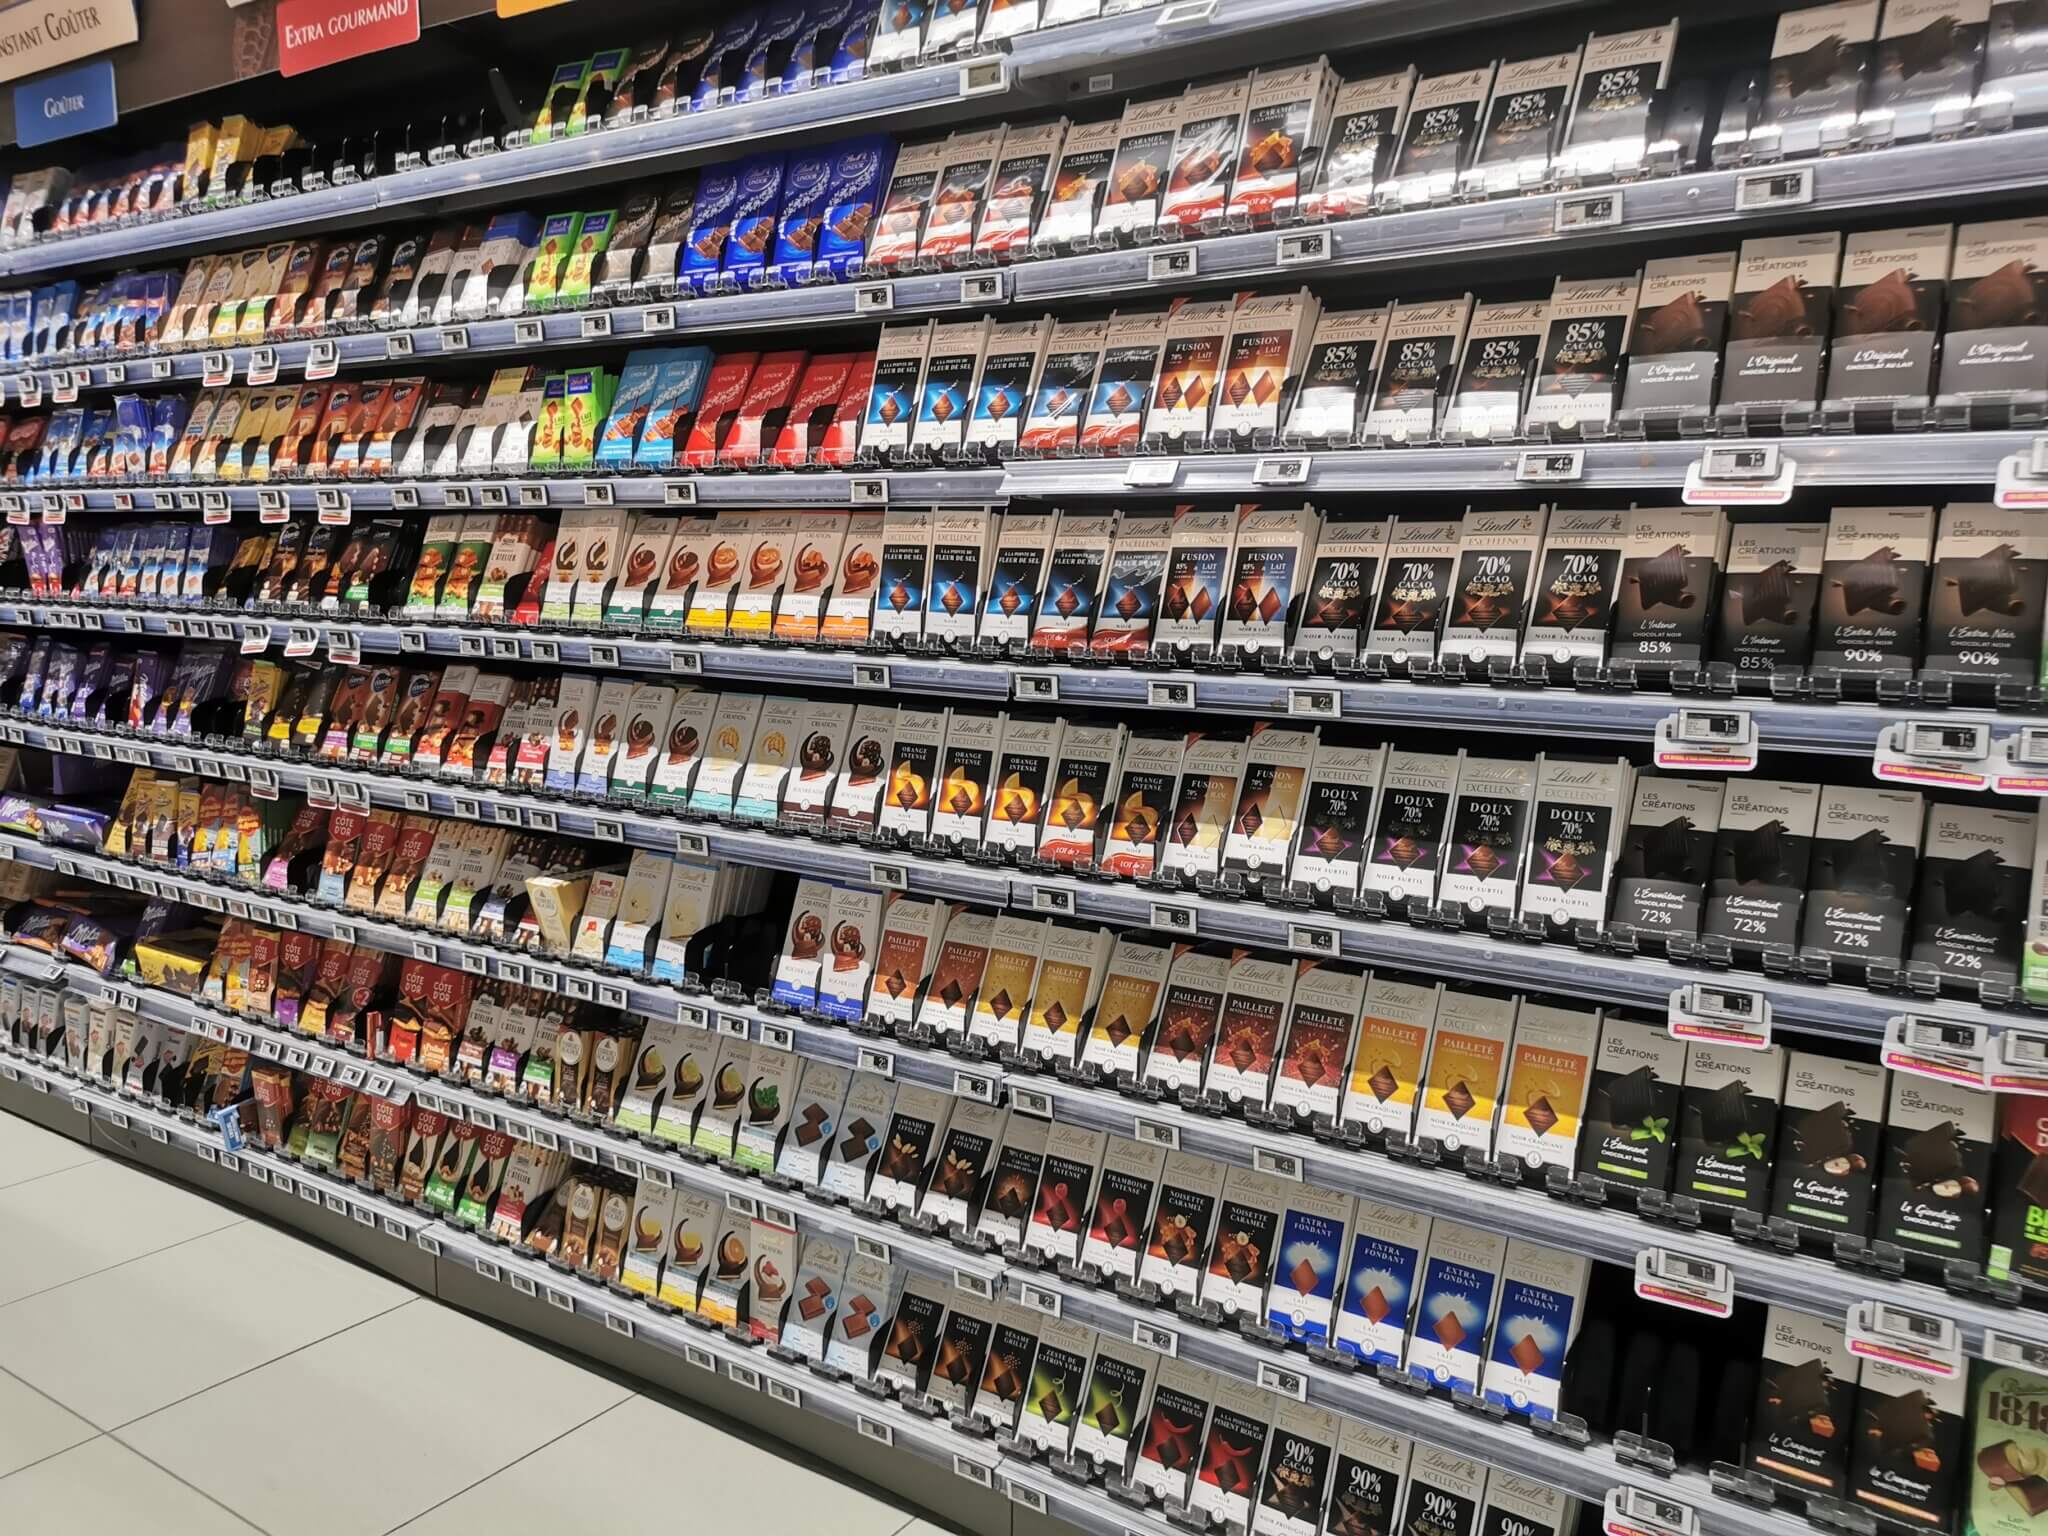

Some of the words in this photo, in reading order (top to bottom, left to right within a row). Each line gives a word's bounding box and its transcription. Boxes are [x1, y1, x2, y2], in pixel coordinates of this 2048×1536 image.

[285, 25, 324, 48] EXTRA
[327, 1, 408, 36] GOURMAND
[0, 26, 42, 57] NSTANT
[1345, 112, 1379, 135] 85%
[1423, 107, 1460, 129] 85%
[1566, 282, 1614, 300] Lindt
[1327, 312, 1369, 328] Lindt
[1403, 306, 1445, 322] Lindt
[1485, 307, 1527, 323] Lindt
[1566, 322, 1606, 342] 85%
[1175, 341, 1212, 353] FUSION
[1241, 335, 1281, 348] FUSION
[1264, 345, 1282, 356] LAIT
[1324, 345, 1357, 363] 85%
[1400, 342, 1435, 362] 85%
[1482, 340, 1520, 360] 85%
[1321, 361, 1355, 370] CACAO
[1475, 516, 1517, 532] Lindt
[1560, 513, 1606, 530] Lindt
[1331, 527, 1369, 541] Lindt
[1404, 524, 1445, 539] Lindt
[935, 553, 957, 561] FLEUR
[999, 556, 1021, 564] FLEUR
[1181, 553, 1216, 562] FUSION
[1248, 552, 1285, 562] FUSION
[1477, 555, 1511, 574] 70%
[1563, 554, 1599, 573] 70%
[1270, 563, 1286, 572] LAIT
[1329, 562, 1359, 580] 70%
[1402, 563, 1434, 580] 70%
[1326, 580, 1358, 588] CACAO
[1399, 580, 1433, 589] CACAO
[1473, 575, 1509, 583] CACAO
[1559, 575, 1598, 583] CACAO
[1638, 640, 1672, 654] 85%
[1740, 656, 1774, 669] 85%
[1844, 648, 1882, 663] 90%
[1958, 650, 2000, 666] 90%
[901, 752, 927, 761] INTENSE
[902, 746, 928, 754] ORANGE
[954, 756, 981, 766] INTENSE
[1009, 763, 1037, 773] INTENSE
[1010, 758, 1038, 766] ORANGE
[1069, 763, 1098, 771] ORANGE
[1067, 769, 1098, 778] INTENSE
[1131, 781, 1163, 791] INTENSE
[1321, 787, 1359, 801] DOUX
[1395, 794, 1435, 808] DOUX
[1329, 799, 1347, 812] 70%
[1403, 806, 1422, 819] 70%
[1470, 802, 1513, 816] DOUX
[1641, 800, 1696, 812] CRÉATIONS
[1731, 802, 1789, 815] CRÉATIONS
[1828, 803, 1847, 811] LES
[334, 815, 354, 826] CÔTE
[1480, 814, 1500, 827] 70%
[1550, 808, 1596, 823] DOUX
[1828, 810, 1890, 824] CRÉATIONS
[334, 825, 352, 835] D'OR
[1561, 821, 1582, 835] 70%
[1940, 822, 1959, 830] LES
[368, 832, 385, 843] CÔTE
[1939, 829, 2005, 845] CRÉATIONS
[366, 840, 383, 852] D'OR
[1641, 909, 1671, 925] 72%
[1733, 918, 1767, 934] 72%
[1833, 930, 1869, 948] 72%
[255, 944, 268, 954] CÔTE
[255, 952, 267, 961] D'OR
[285, 944, 300, 954] CÔTE
[285, 952, 300, 961] D'OR
[1944, 951, 1982, 970] 72%
[1173, 989, 1218, 1007] PAILLETÉ
[1231, 997, 1276, 1016] PAILLETÉ
[1299, 1009, 1345, 1028] PAILLETÉ
[1369, 1022, 1418, 1039] PAILLETÉ
[1443, 1037, 1495, 1055] PAILLETÉ
[1607, 1037, 1623, 1047] LES
[1606, 1045, 1660, 1062] CRÉATIONS
[1696, 1051, 1713, 1061] LES
[1695, 1059, 1752, 1075] CRÉATIONS
[1796, 1071, 1814, 1081] LES
[1795, 1079, 1856, 1097] CRÉATIONS
[1050, 1159, 1088, 1173] FRAMBOISE
[1168, 1197, 1202, 1212] CARAMEL
[1230, 1206, 1269, 1222] NOISETTE
[1230, 1213, 1266, 1230] CARAMEL
[1301, 1215, 1327, 1227] EXTRA
[1294, 1222, 1332, 1238] FONDANT
[1371, 1241, 1401, 1256] EXTRA
[1364, 1249, 1405, 1265] FONDANT
[1438, 1271, 1481, 1289] FONDANT
[1446, 1265, 1476, 1280] EXTRA
[1522, 1287, 1554, 1302] EXTRA
[1514, 1294, 1560, 1312] FONDANT
[1103, 1361, 1124, 1371] ZESTE
[1096, 1364, 1121, 1379] CITRON
[1122, 1372, 1142, 1385] VERT
[1156, 1397, 1180, 1411] PIMENT
[1181, 1404, 1204, 1418] ROUGE
[1285, 1439, 1314, 1465] 90%
[1282, 1458, 1312, 1474] CACAO
[1351, 1465, 1382, 1493] 90%
[1348, 1485, 1380, 1503] CACAO
[1424, 1491, 1457, 1520] 90%
[1422, 1513, 1455, 1530] CACAO
